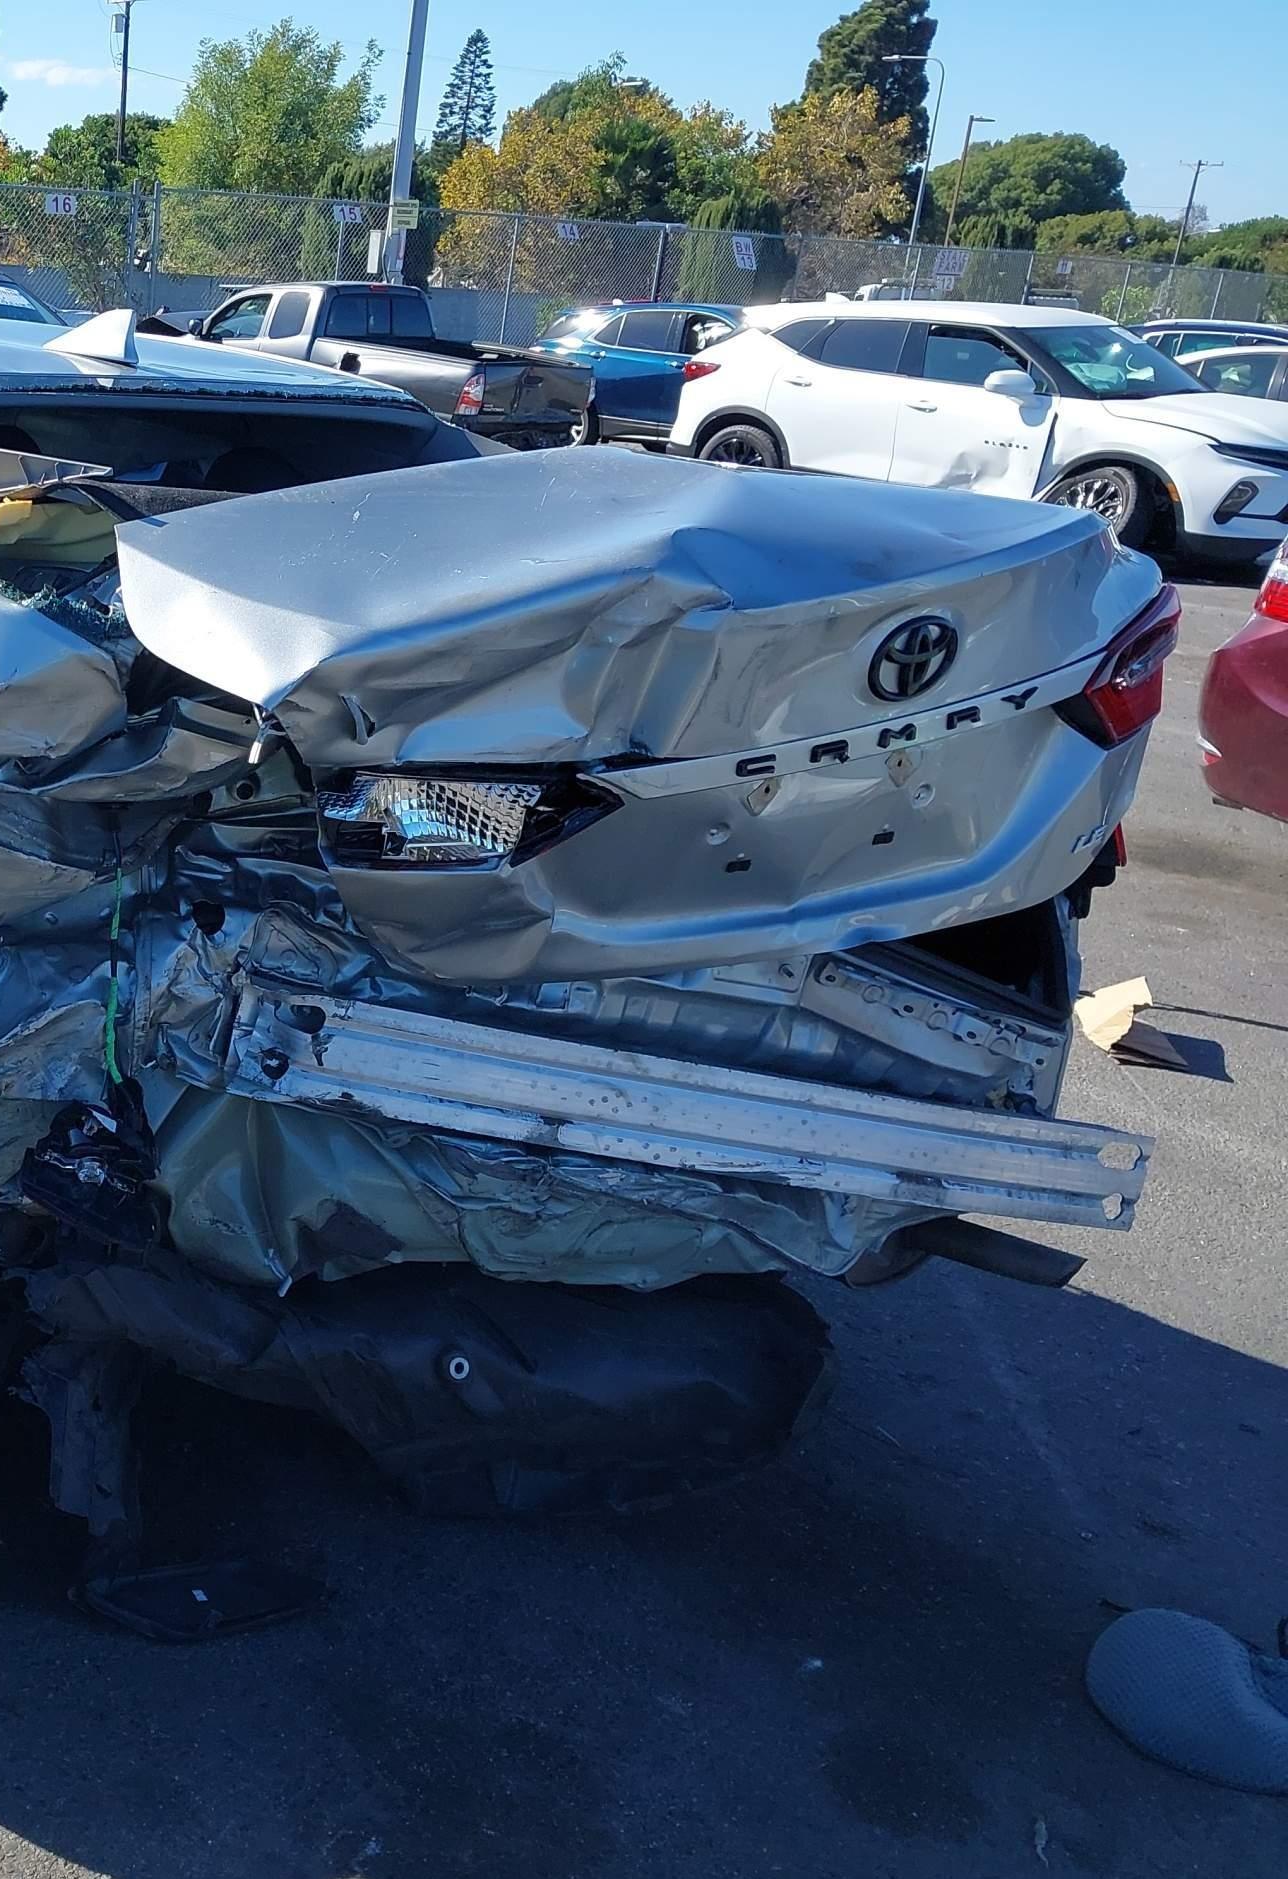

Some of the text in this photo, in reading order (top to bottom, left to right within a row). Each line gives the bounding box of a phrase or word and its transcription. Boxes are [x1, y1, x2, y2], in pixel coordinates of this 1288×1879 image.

[52, 195, 72, 213] 16
[339, 207, 357, 221] 15
[562, 224, 576, 237] 14
[734, 685, 1040, 778] CAMRY
[1071, 824, 1109, 854] LE
